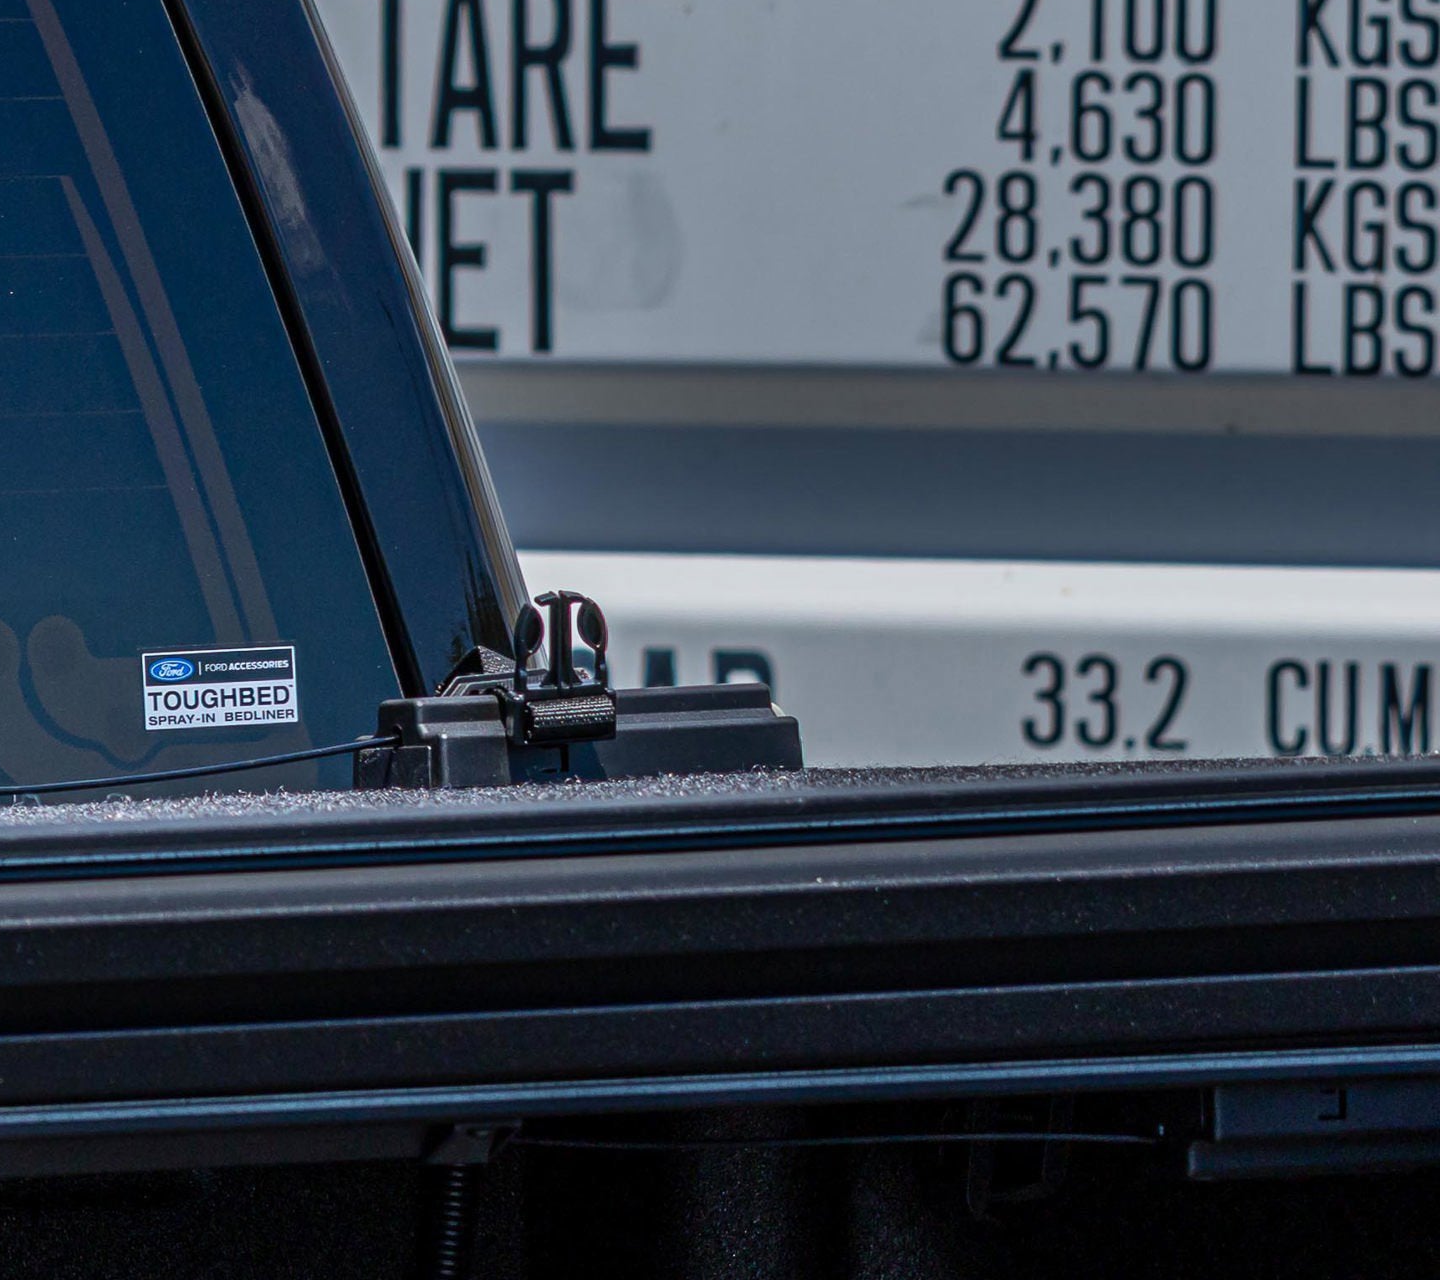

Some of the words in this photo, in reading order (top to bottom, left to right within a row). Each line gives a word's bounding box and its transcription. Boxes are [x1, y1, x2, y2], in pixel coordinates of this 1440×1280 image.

[995, 66, 1217, 168] 4,630
[1293, 74, 1439, 173] LBS
[407, 167, 576, 353] ET
[941, 168, 1215, 270] 28,380
[1292, 176, 1439, 275] KGS
[940, 270, 1215, 374] 62,570
[1291, 279, 1437, 379] LBS
[148, 713, 216, 726] SPRAY-IN
[224, 708, 295, 722] BEDLINER
[204, 663, 228, 672] FORD
[229, 659, 290, 671] ACCESSORIES
[1020, 650, 1191, 751] 33.2
